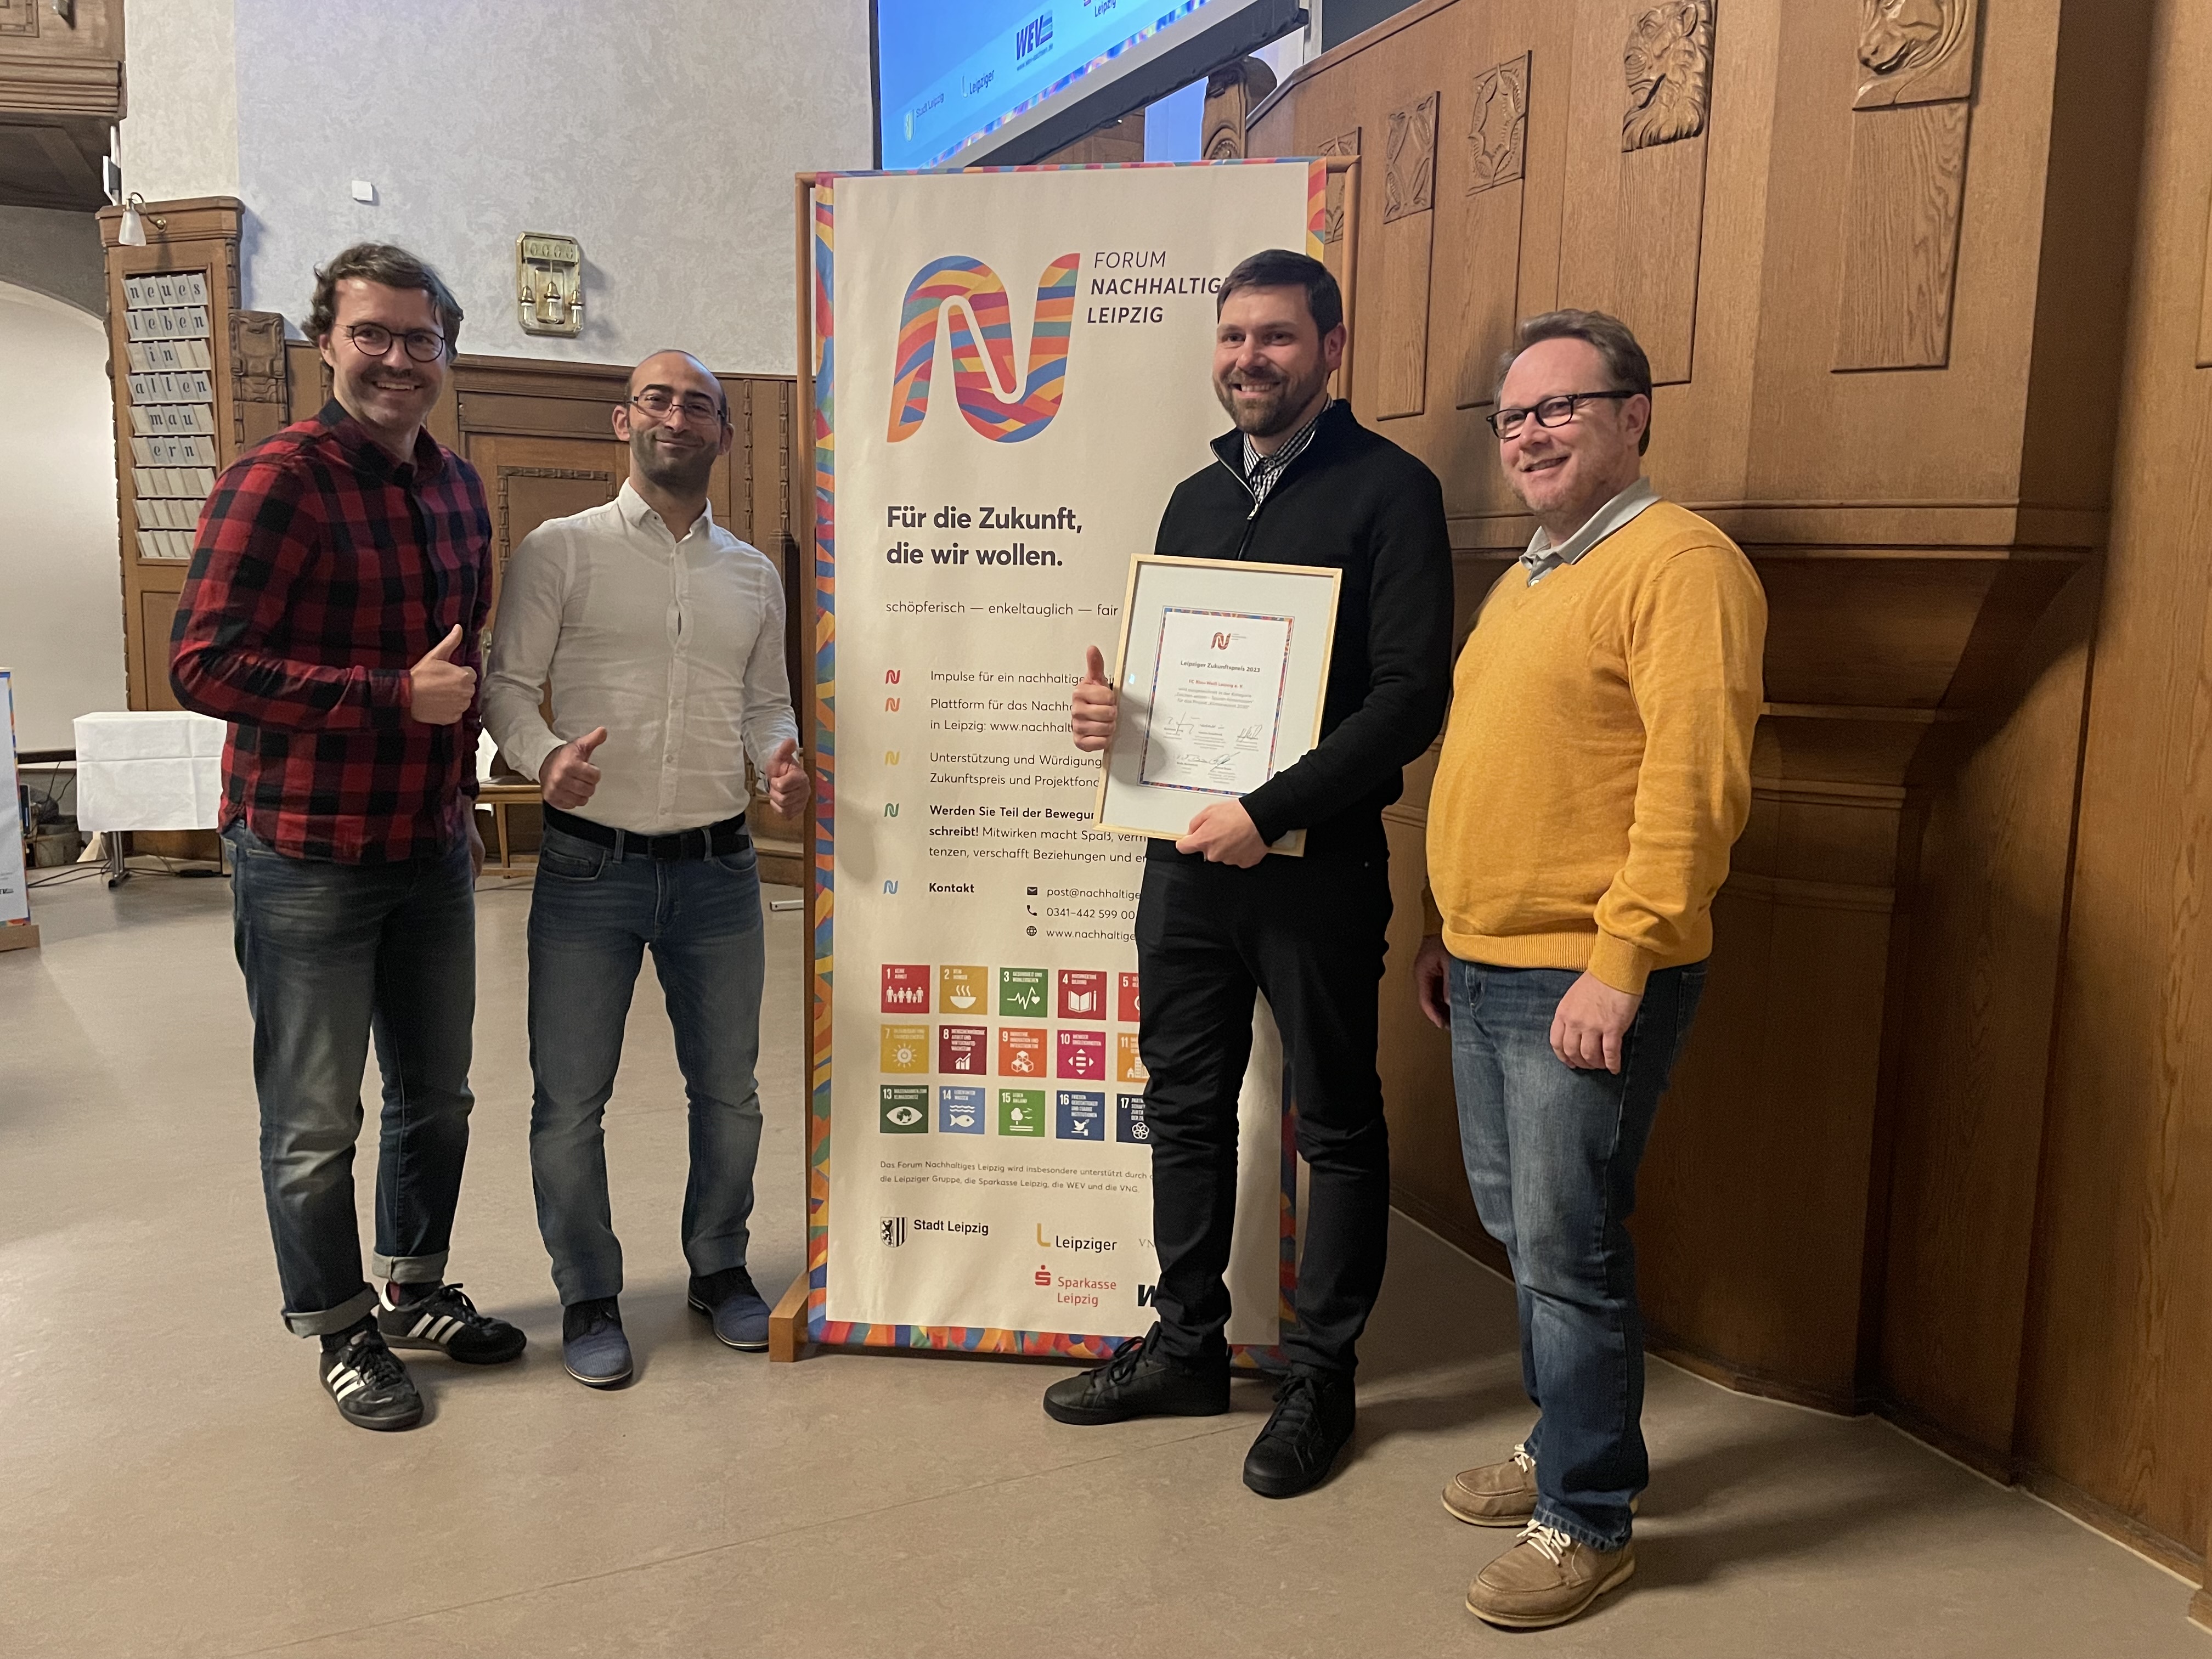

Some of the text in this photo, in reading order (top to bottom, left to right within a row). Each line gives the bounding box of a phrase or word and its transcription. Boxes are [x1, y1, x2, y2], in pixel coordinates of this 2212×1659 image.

[1017, 15, 1044, 60] WEV
[969, 70, 995, 94] Leipziger
[1094, 251, 1166, 269] FORUM
[129, 283, 201, 299] neues
[1091, 276, 1228, 295] NACHHALTIG
[1087, 306, 1164, 324] LEIPZIG
[133, 314, 205, 331] leben
[149, 346, 173, 362] in
[149, 414, 193, 426] mau
[153, 445, 195, 458] ern
[886, 505, 1082, 534] Für die Zukunft,
[886, 541, 1063, 566] die wir wollen.
[885, 600, 966, 614] schöpferisch
[988, 601, 1074, 617] enkeltauglich
[1097, 603, 1119, 616] fair
[1180, 660, 1206, 668] Leipziger
[1207, 663, 1245, 672] Zukunftspreis
[930, 670, 975, 684] Impulse
[978, 670, 995, 682] für
[997, 672, 1014, 683] ein
[930, 698, 985, 710] Plattform
[988, 698, 1003, 710] für
[1007, 700, 1028, 711] das
[930, 720, 940, 730] in
[944, 720, 986, 733] Leipzig:
[929, 752, 1010, 766] Unterstützung
[1013, 754, 1035, 765] und
[1039, 754, 1102, 769] Würdigung
[929, 772, 1006, 786] Zukunftspreis
[1009, 774, 1031, 785] und
[929, 805, 975, 816] Werden
[979, 805, 996, 817] Sie
[1000, 806, 1019, 817] Teil
[1022, 807, 1041, 819] der
[929, 826, 979, 838] schreibt!
[982, 827, 1037, 839] Mitwirken
[1040, 829, 1077, 840] macht
[1081, 830, 1114, 843] Spaß,
[929, 847, 969, 859] tenzen,
[973, 848, 1030, 859] verschafft
[1034, 849, 1106, 864] Beziehungen
[1110, 852, 1131, 862] und
[929, 882, 975, 894] Kontakt
[1047, 888, 1141, 901] post@nachhaltige
[1098, 909, 1118, 919] 599
[1121, 910, 1136, 919] 00
[1046, 929, 1136, 943] www.nachhaltige
[886, 968, 890, 979] 1
[944, 968, 950, 980] 2
[1003, 971, 1009, 982] 3
[1062, 973, 1069, 984] 4
[1122, 976, 1128, 987] 5
[885, 1028, 890, 1039] 7
[943, 1028, 949, 1040] 8
[1002, 1031, 1008, 1042] 9
[1060, 1033, 1070, 1045] 10
[1121, 1036, 1128, 1048] 11
[883, 1088, 892, 1099] 13
[942, 1089, 952, 1100] 14
[1002, 1092, 1011, 1103] 15
[1059, 1094, 1069, 1105] 16
[1120, 1097, 1130, 1109] 17
[880, 1160, 895, 1169] Das
[897, 1161, 923, 1169] Forum
[925, 1161, 975, 1171] Nachhaltiges
[978, 1163, 1005, 1173] Leipzig
[1026, 1166, 1077, 1175] insbesondere
[1080, 1169, 1122, 1177] unterstützt
[1125, 1171, 1147, 1179] durch
[894, 1175, 929, 1184] Leipziger
[932, 1175, 963, 1186] Gruppe,
[978, 1178, 1018, 1187] Sparkasse
[1020, 1180, 1050, 1189] Leipzig,
[913, 1219, 989, 1236] Stadt Leipzig
[1055, 1235, 1118, 1254] Leipziger
[1057, 1276, 1117, 1291] Sparkasse
[1057, 1293, 1099, 1307] Leipzig
